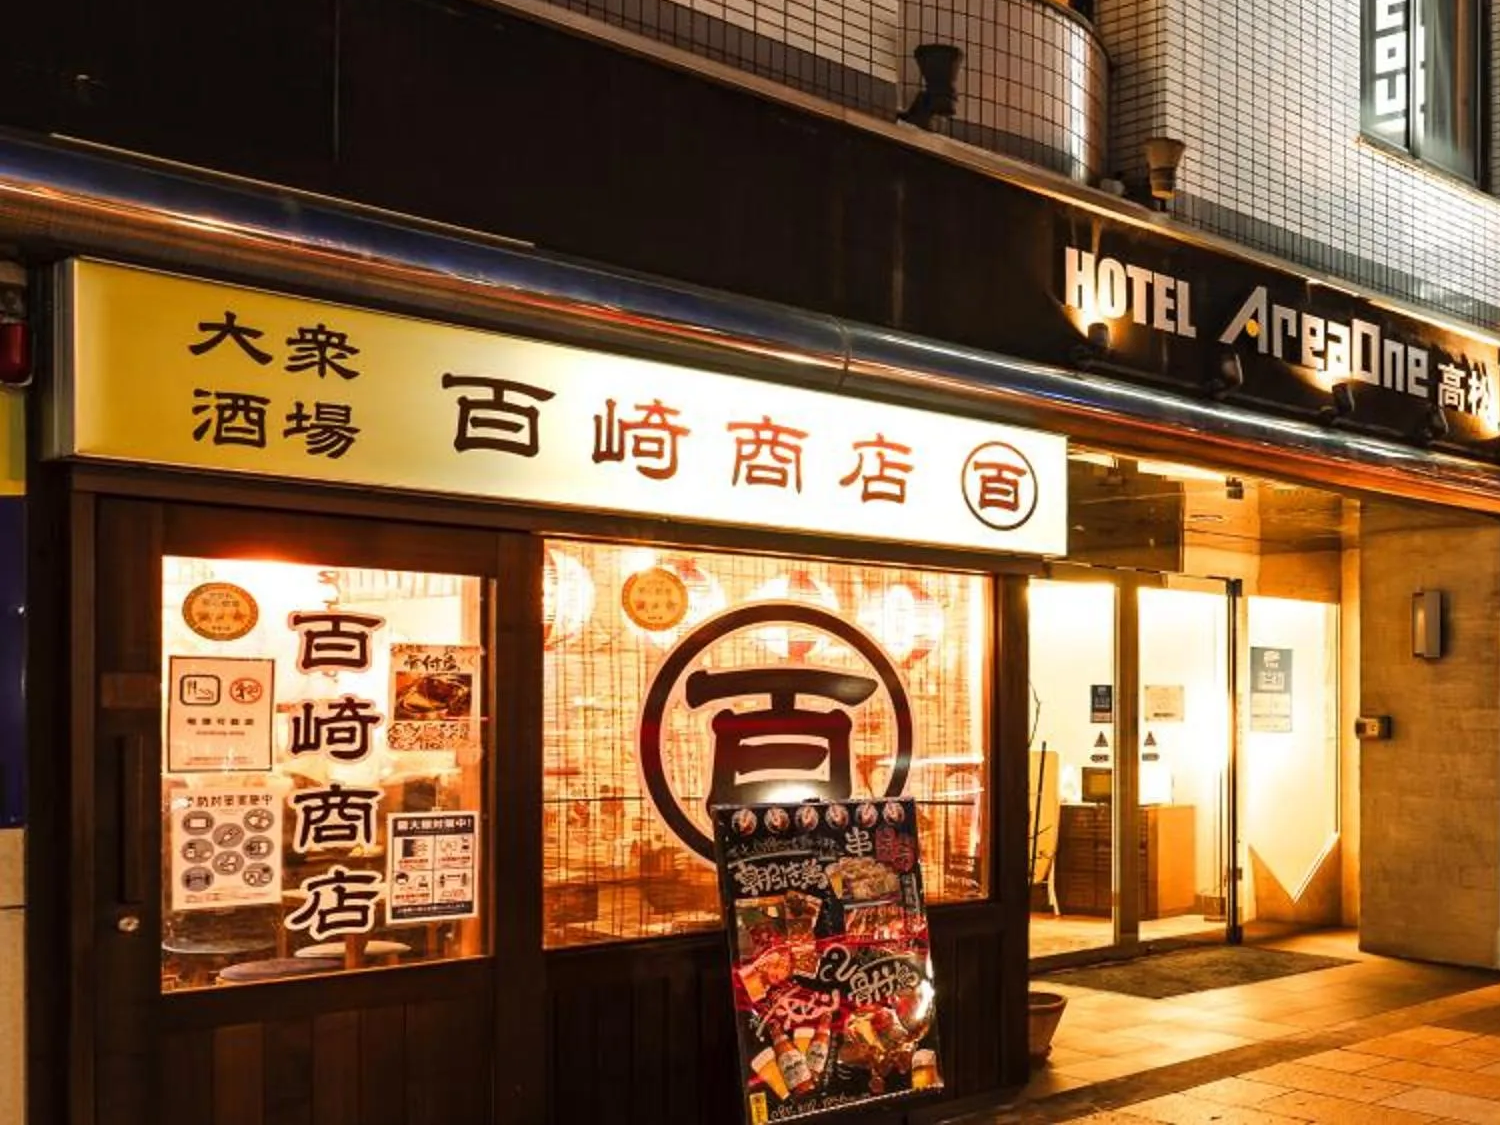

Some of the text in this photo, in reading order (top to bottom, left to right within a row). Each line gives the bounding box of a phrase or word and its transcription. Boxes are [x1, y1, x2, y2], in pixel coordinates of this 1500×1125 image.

[188, 310, 361, 381] 大衆
[1065, 246, 1197, 339] HOTEL
[1219, 285, 1429, 398] AreaOne
[191, 387, 362, 459] 酒場
[442, 372, 916, 505] 百崎商店
[972, 458, 1029, 513] 百
[287, 611, 385, 939] 百崎商店
[685, 667, 878, 805] 百
